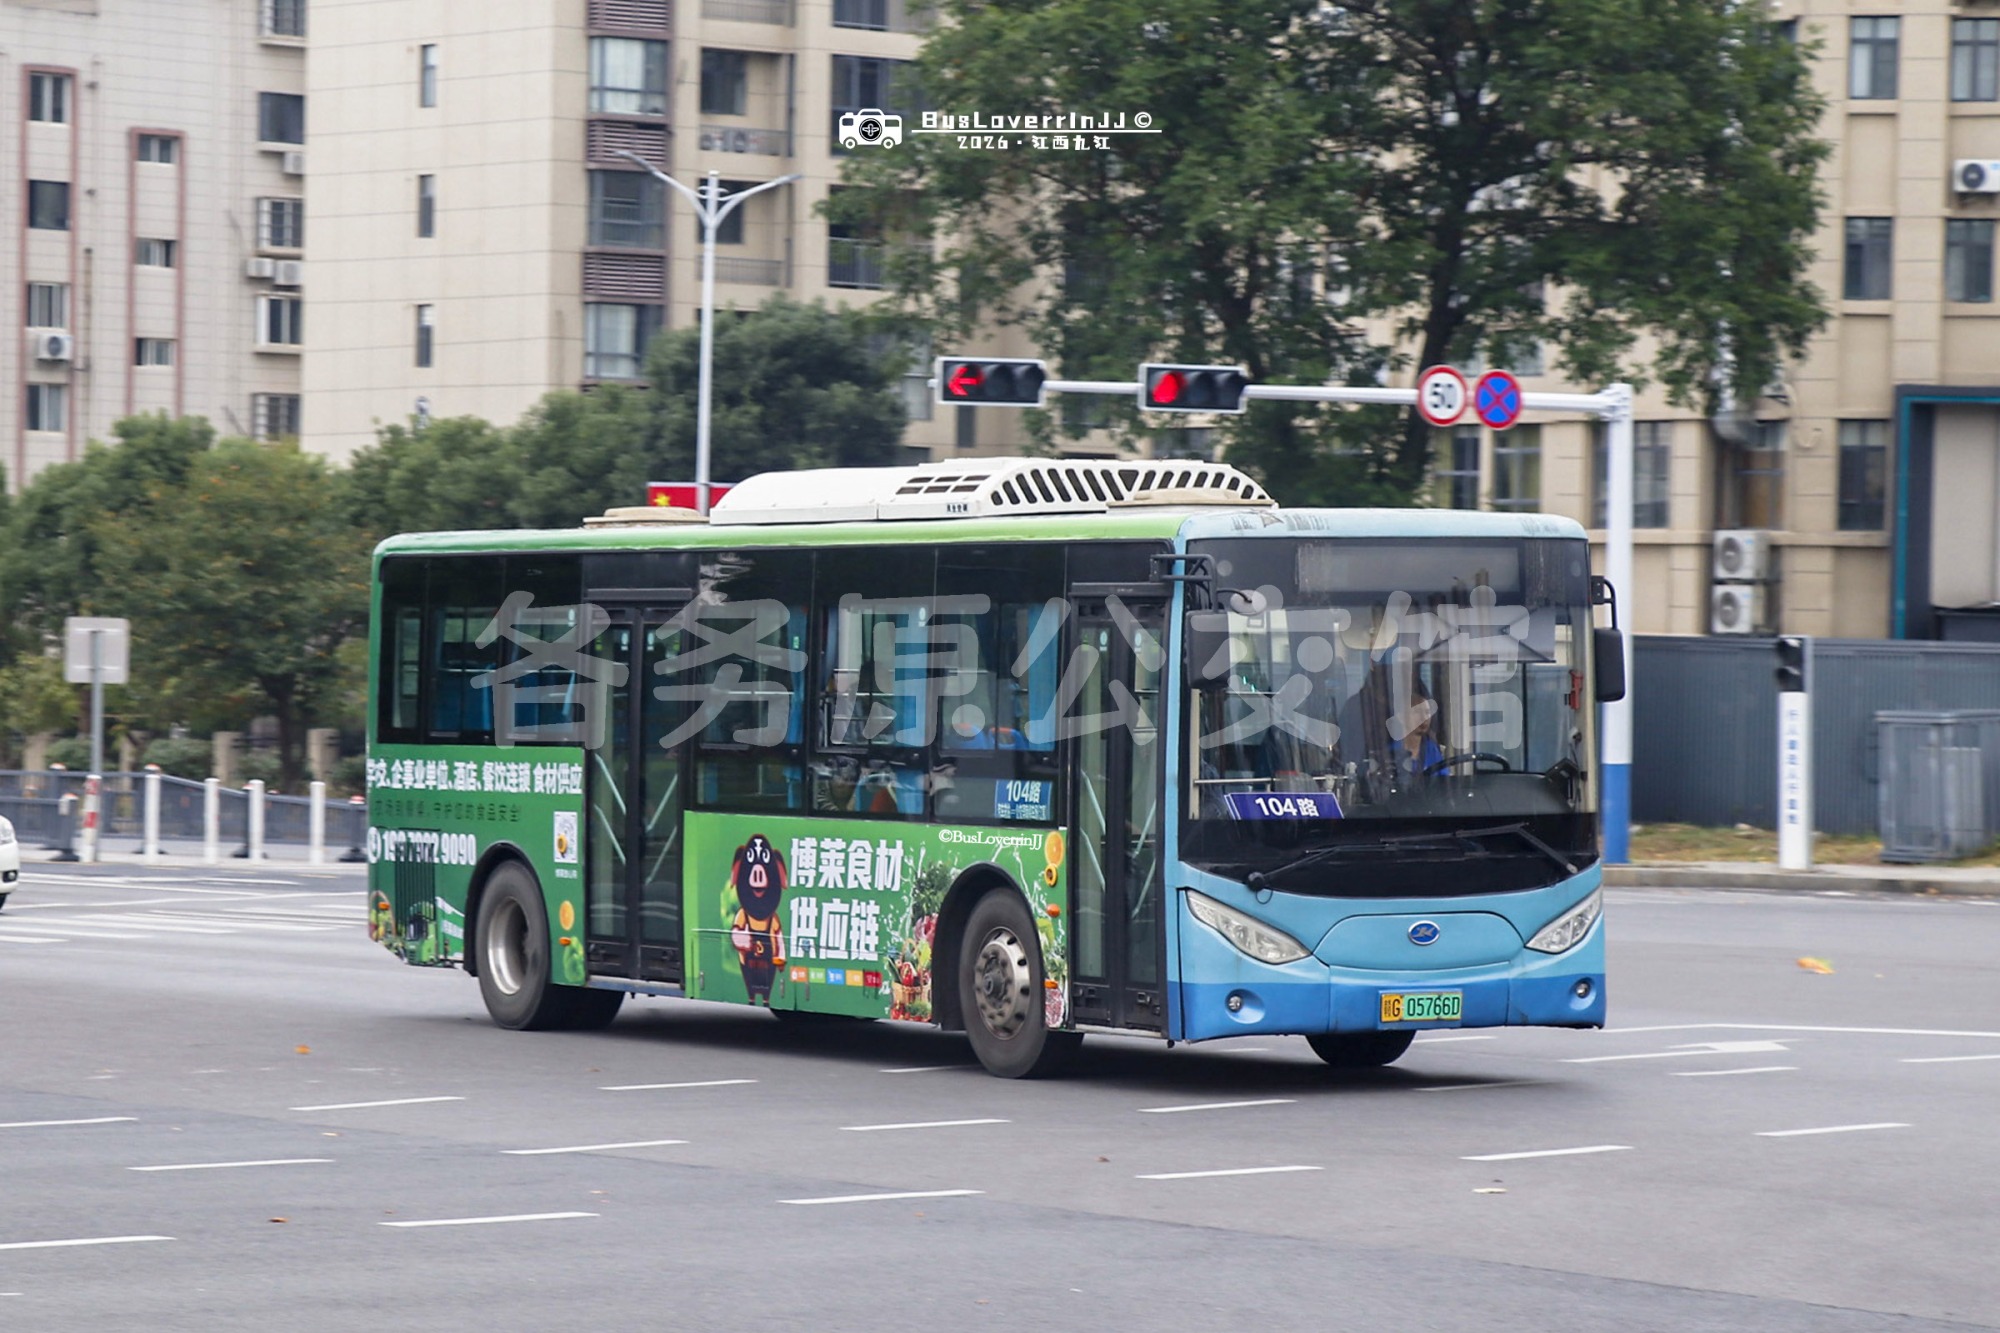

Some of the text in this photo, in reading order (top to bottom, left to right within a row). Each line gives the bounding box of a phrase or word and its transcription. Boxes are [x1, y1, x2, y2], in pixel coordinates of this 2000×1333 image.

[1430, 382, 1457, 409] 50
[533, 762, 583, 795] 食材供应
[1006, 780, 1041, 803] 104路
[1255, 797, 1319, 817] 104路
[441, 832, 477, 866] 9090
[790, 837, 904, 891] 博莱食材
[789, 896, 880, 961] 供应链
[1407, 996, 1461, 1017] 05766D
